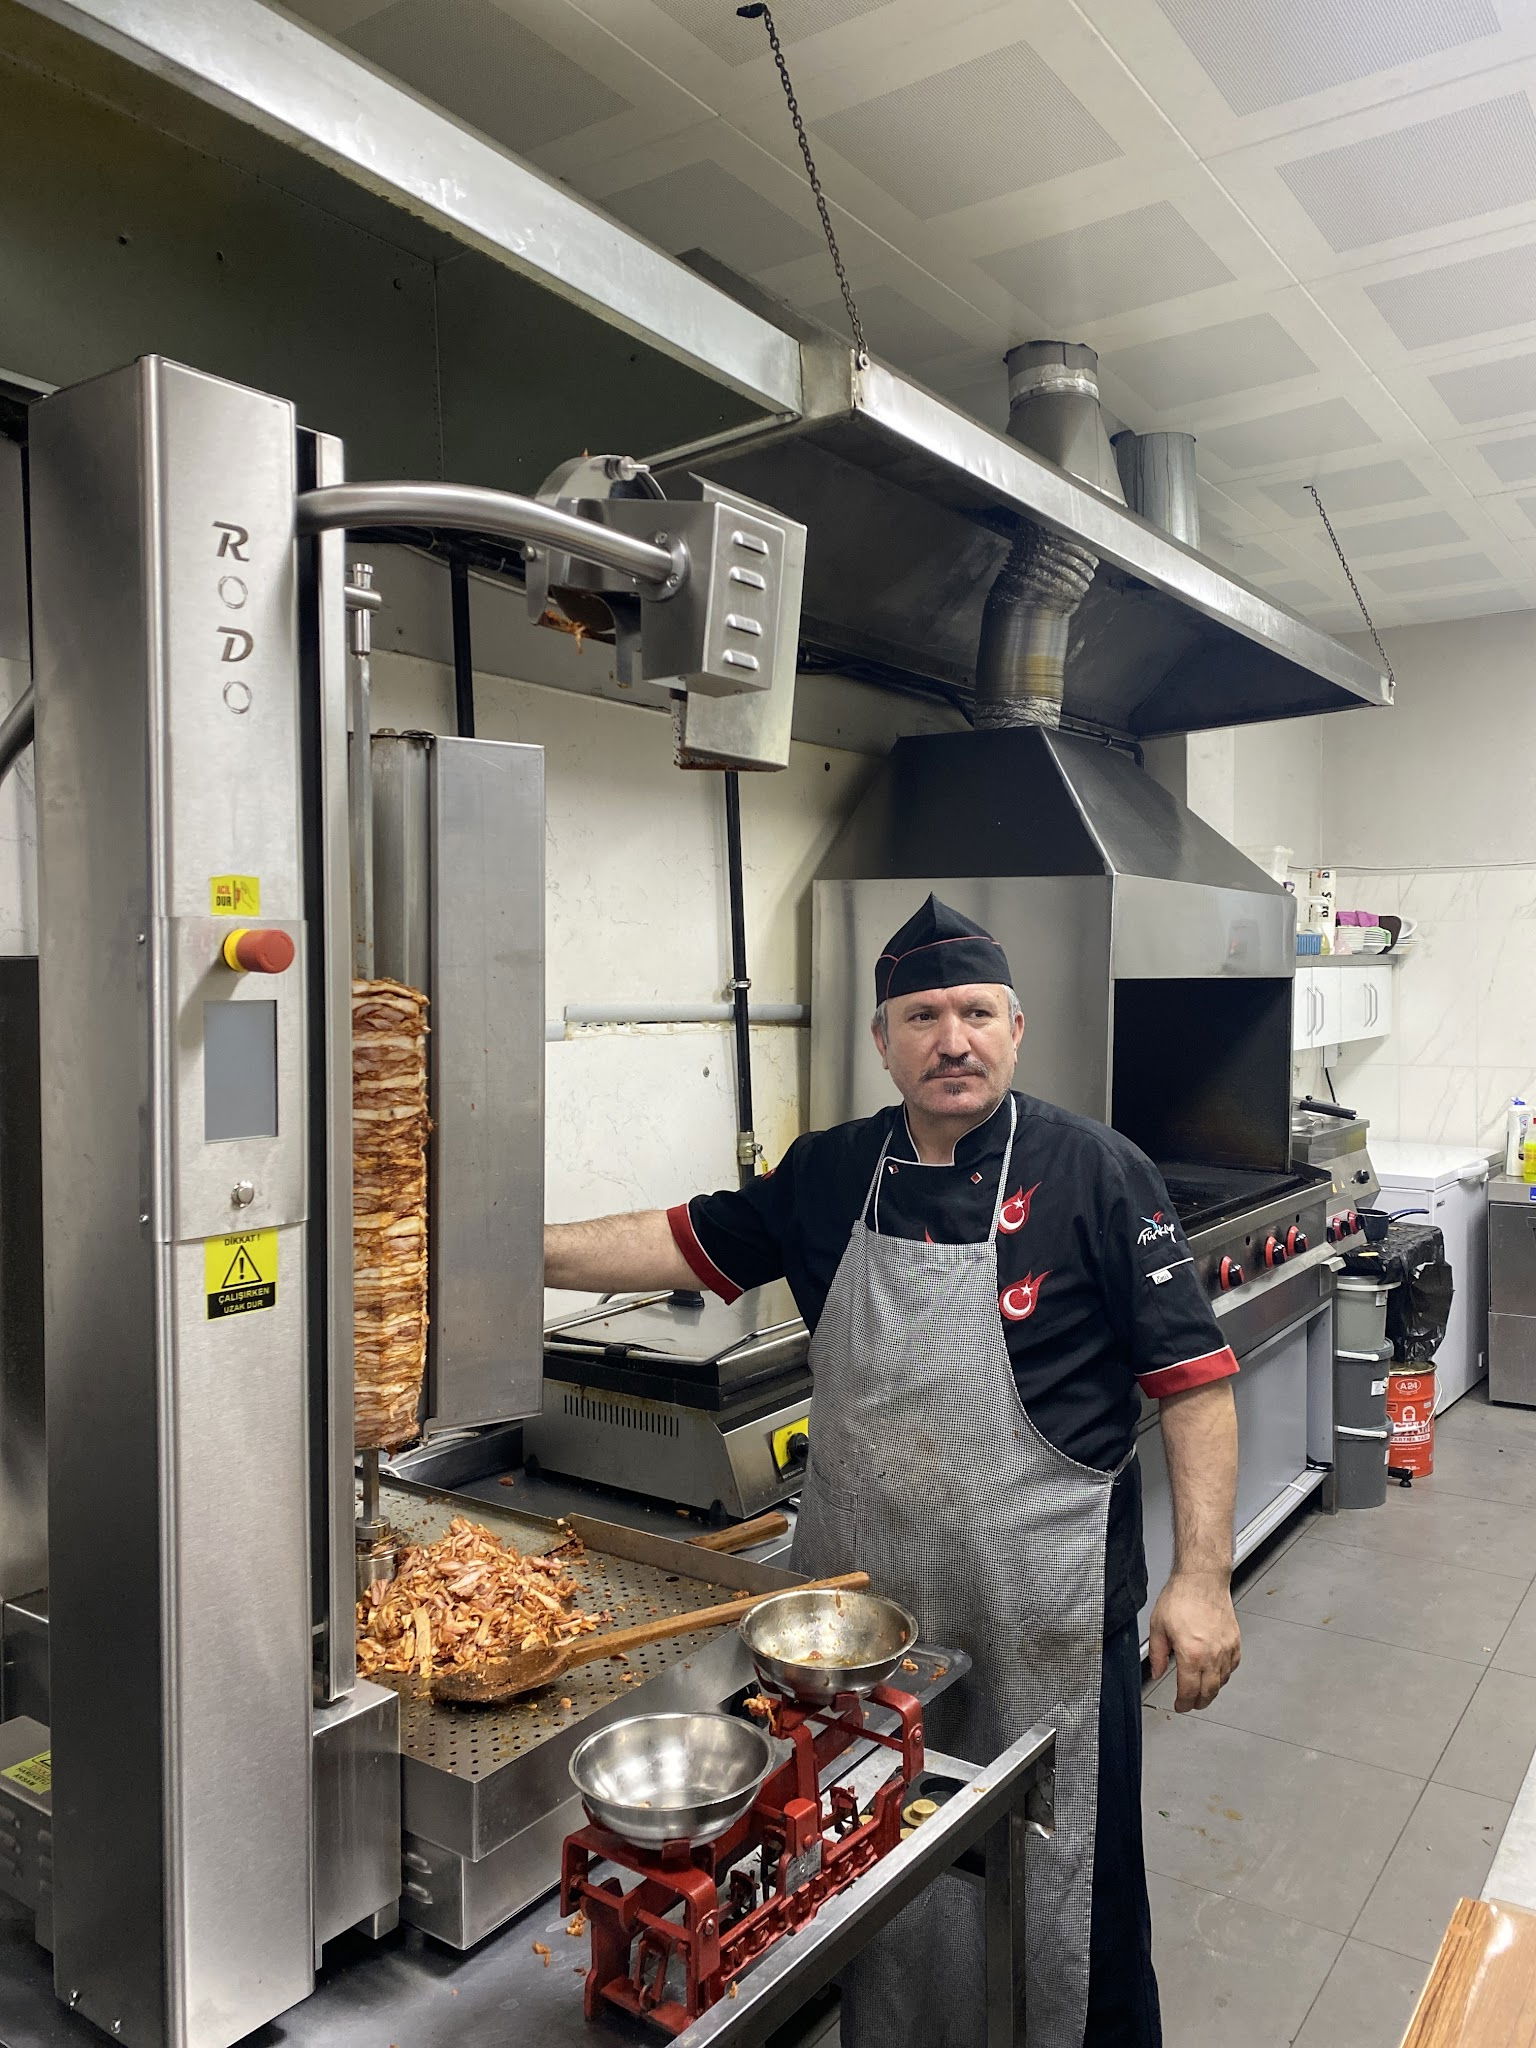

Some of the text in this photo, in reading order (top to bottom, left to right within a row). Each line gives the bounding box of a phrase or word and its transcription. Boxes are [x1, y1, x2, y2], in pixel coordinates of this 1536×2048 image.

[212, 521, 254, 715] RODO
[216, 896, 232, 907] DUR
[1321, 892, 1331, 917] Sra
[224, 1234, 256, 1246] DİKKAT
[218, 1287, 270, 1305] ÇALIŞIRKEN
[224, 1300, 264, 1314] UZAK DUR
[1400, 1382, 1418, 1391] A24
